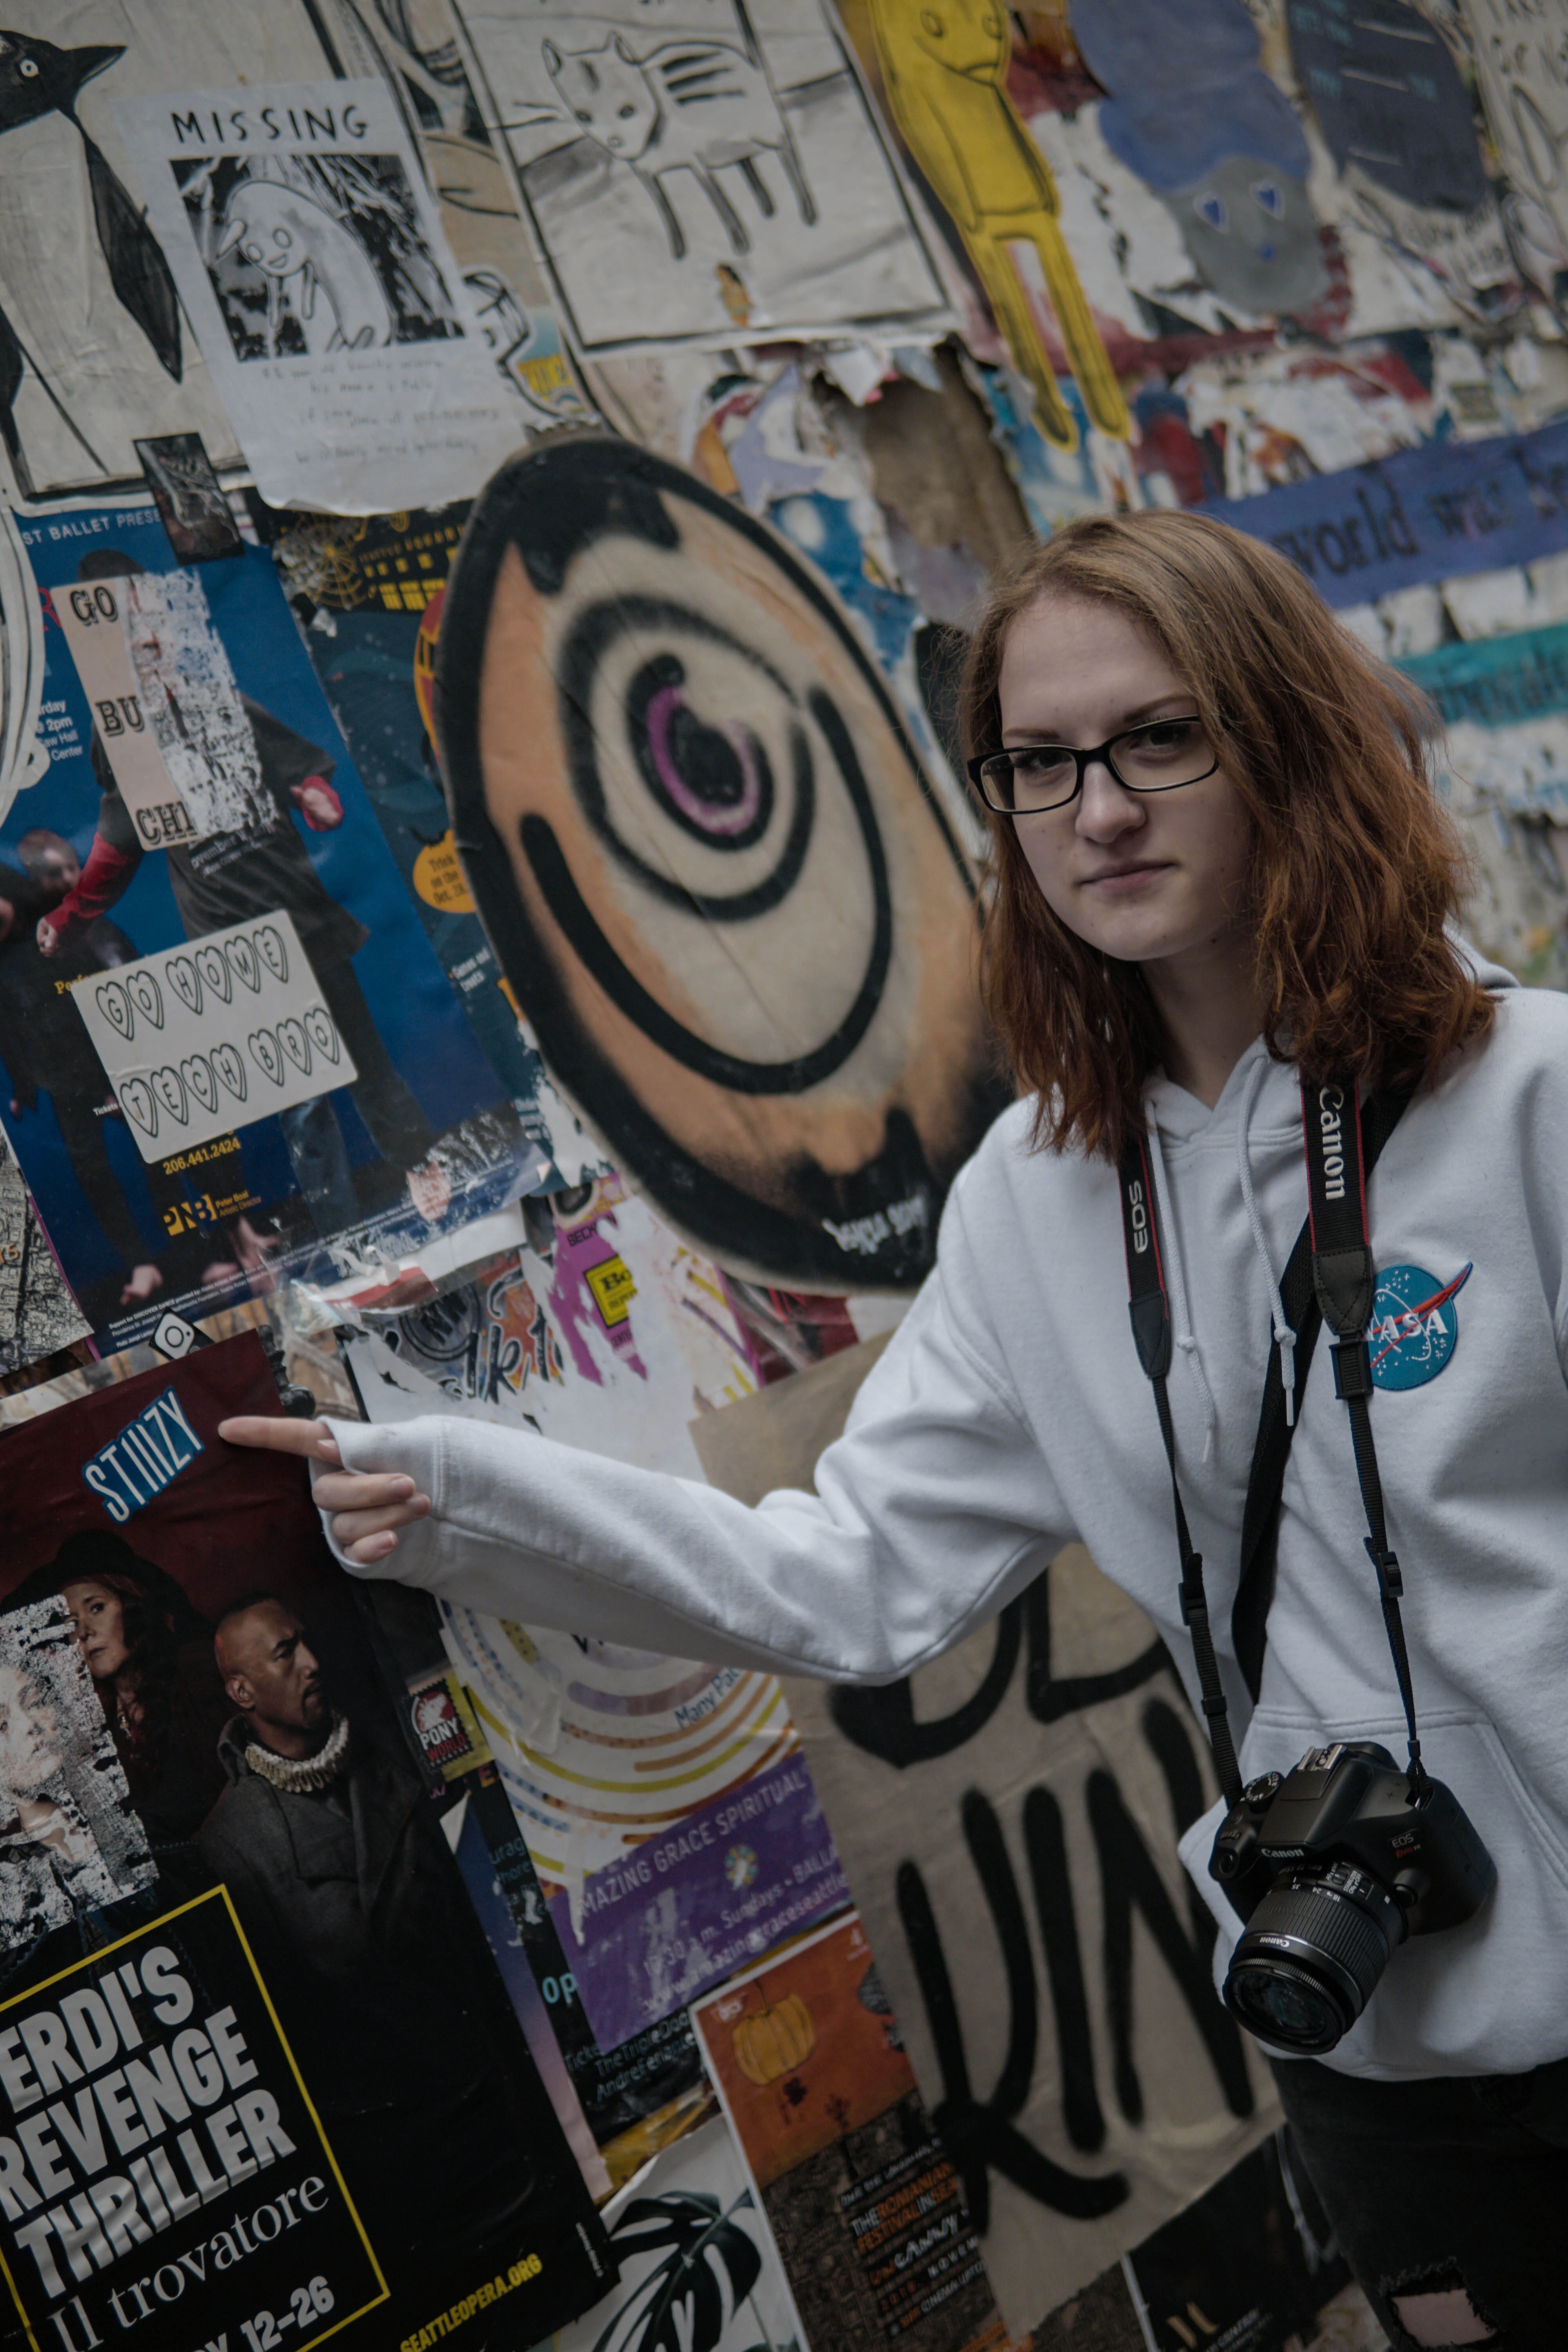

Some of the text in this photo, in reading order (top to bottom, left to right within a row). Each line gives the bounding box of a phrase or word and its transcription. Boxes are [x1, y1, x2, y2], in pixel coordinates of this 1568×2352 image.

[171, 105, 368, 143] MISSING
[22, 528, 42, 546] ST
[48, 516, 110, 541] BALLET
[71, 586, 118, 626] GO
[45, 716, 74, 733] 2pm
[95, 695, 144, 737] BU
[51, 746, 83, 761] Center
[59, 729, 79, 744] Hall
[93, 1103, 119, 1118] Tickets
[162, 1136, 242, 1176] 206.441.2424
[1319, 1085, 1346, 1201] Canon
[215, 1197, 234, 1210] Peter
[238, 1196, 262, 1211] Director
[1129, 1179, 1148, 1254] EOS
[85, 1390, 203, 1522] STIIIZY
[674, 1691, 717, 1730] Many
[419, 1717, 459, 1751] PONY
[425, 1732, 467, 1762] WORLD
[653, 1821, 717, 1873] GRACE
[715, 1771, 808, 1836] SPIRITUAL
[1391, 1833, 1414, 1849] EOS
[1261, 1847, 1305, 1859] Canon
[720, 1884, 785, 1929] Sundays
[1259, 1936, 1290, 1948] Canon
[541, 1972, 577, 2008] Op
[0, 1945, 194, 2113] ERDI'S
[0, 2005, 259, 2223] REVENGE
[13, 2089, 297, 2298] THRILLER
[850, 2206, 882, 2236] THE
[857, 2204, 922, 2255] FESTIVAL
[916, 2192, 937, 2215] IN
[47, 2175, 329, 2352] Il trovatore
[400, 2252, 543, 2352] SEATTLEOPERA.ORG
[921, 2280, 960, 2313] CINEMA
